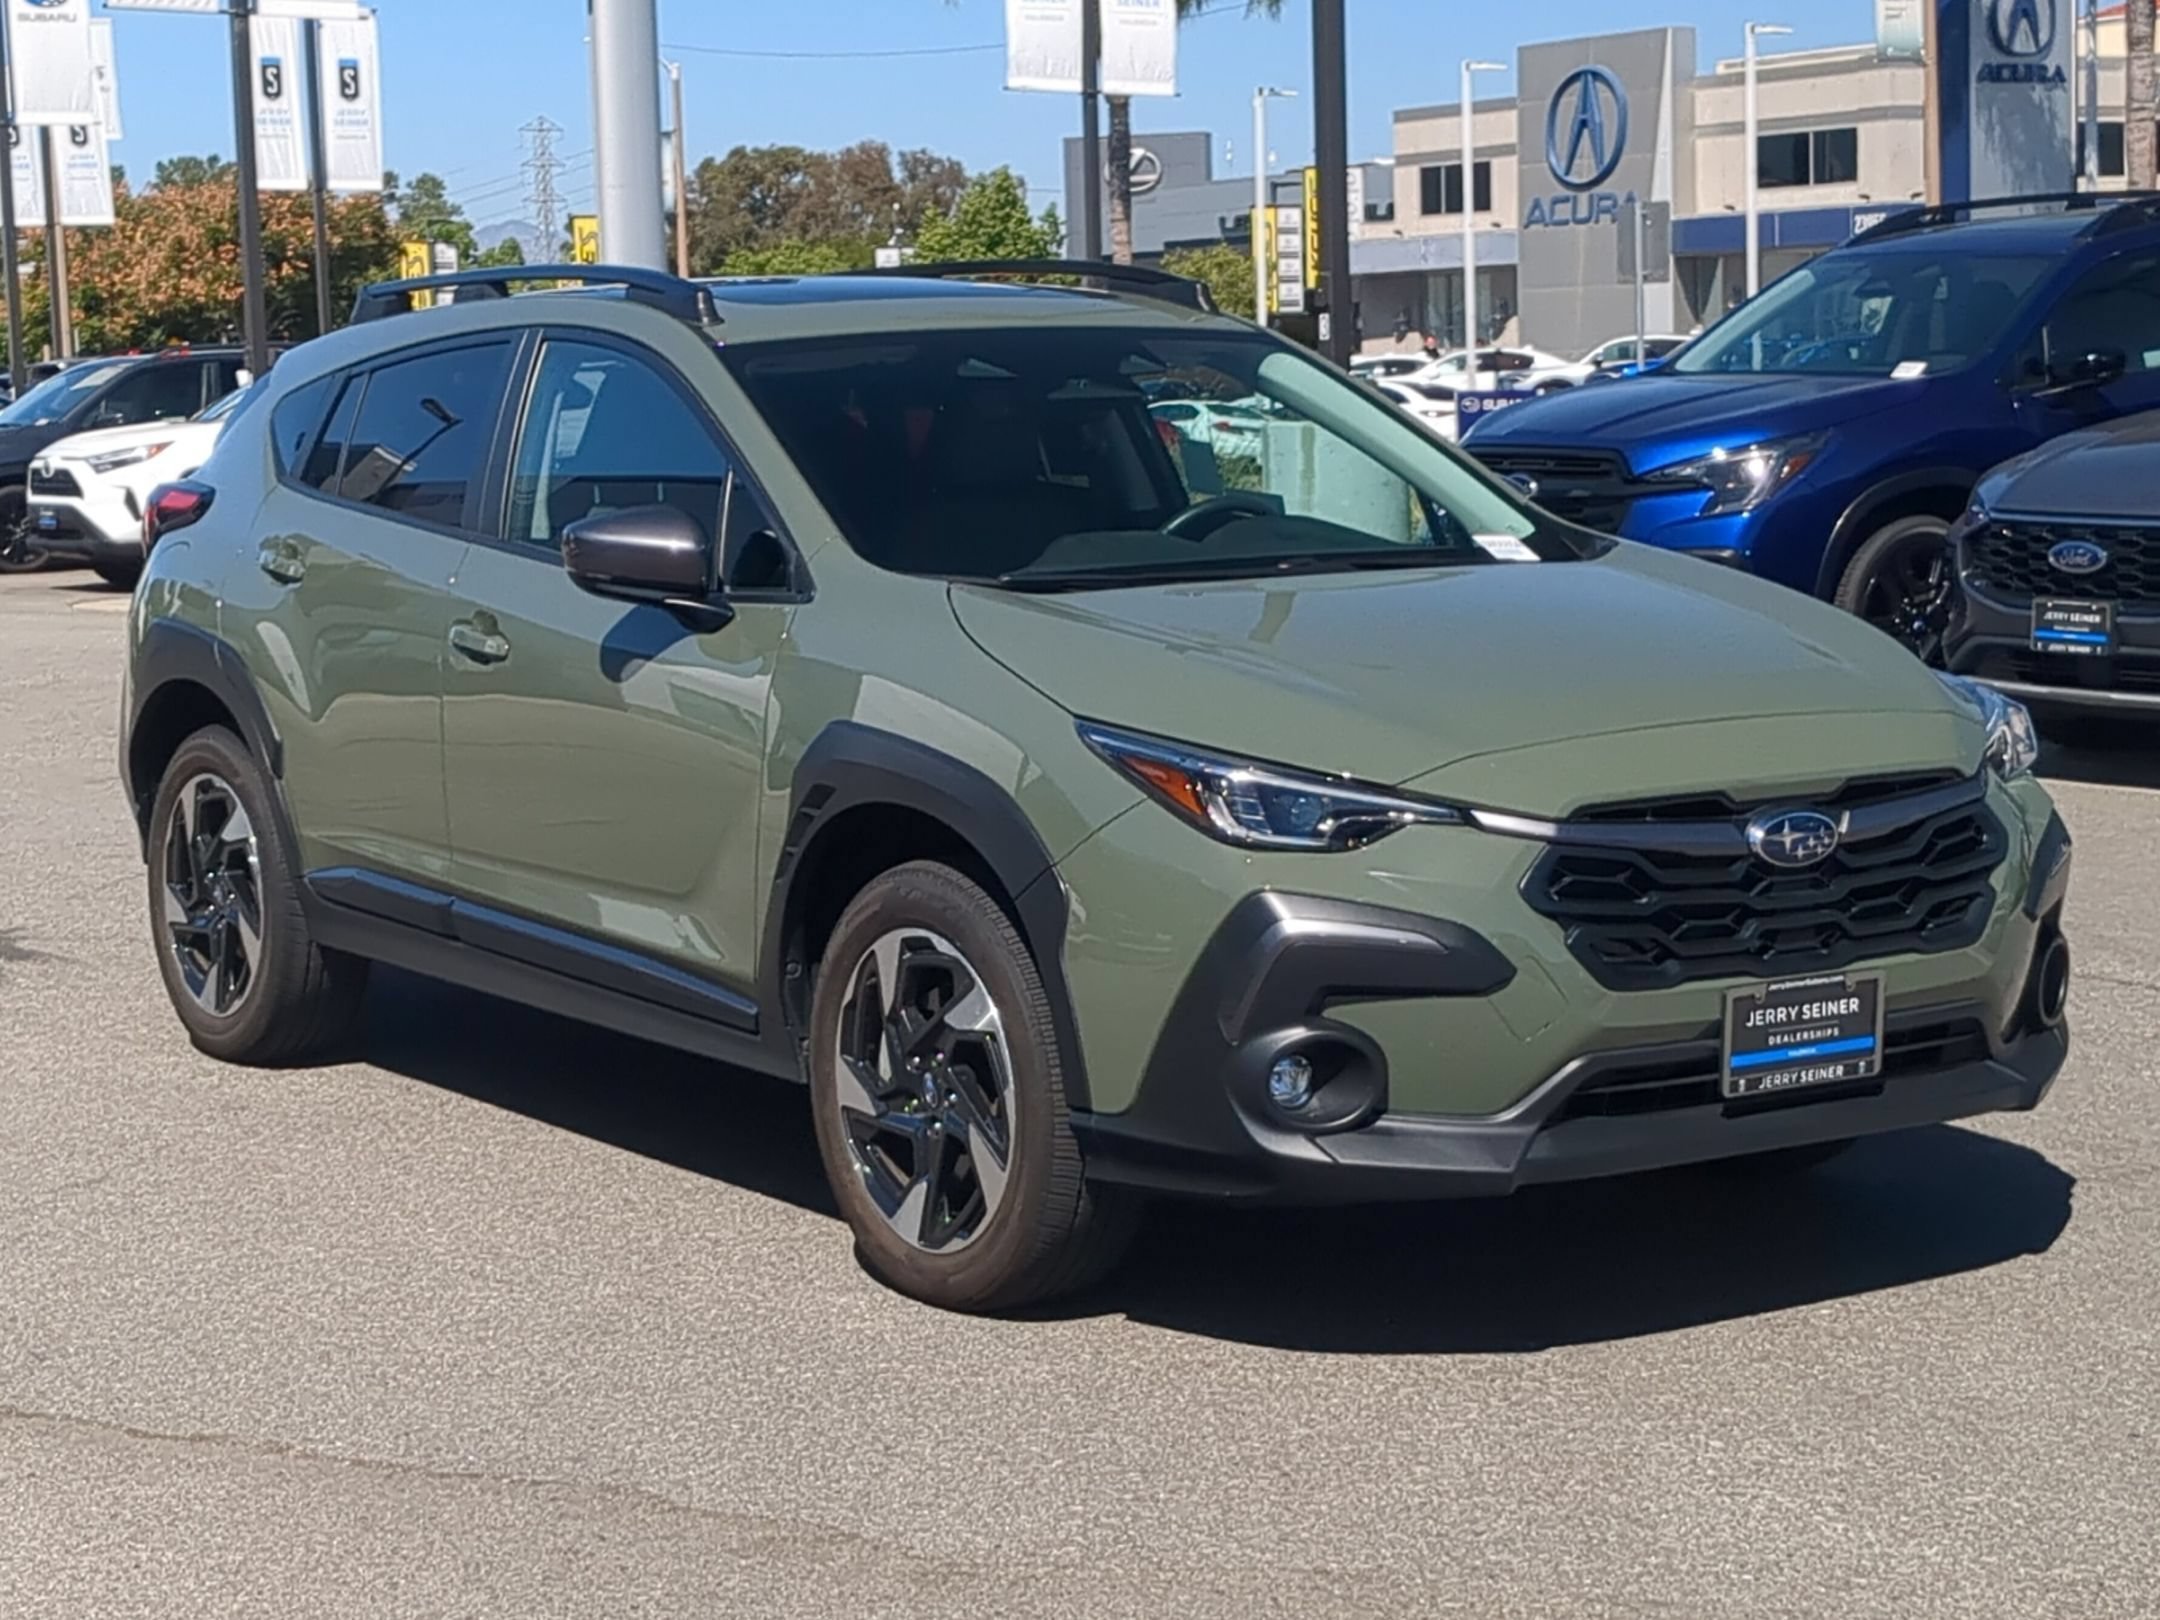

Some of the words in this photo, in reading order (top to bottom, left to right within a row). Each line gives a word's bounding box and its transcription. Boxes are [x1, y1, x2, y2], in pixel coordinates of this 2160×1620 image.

[17, 12, 77, 22] SUBARU
[1975, 62, 2067, 84] ACURA
[2043, 611, 2068, 621] JERRY
[2069, 612, 2101, 624] SEINER
[1745, 1005, 1799, 1028] JERRY
[1801, 997, 1860, 1020] SEINER
[1767, 1026, 1840, 1047] DEALERSHIPS
[1758, 1070, 1799, 1090] JERRY
[1799, 1064, 1845, 1084] SEINER
